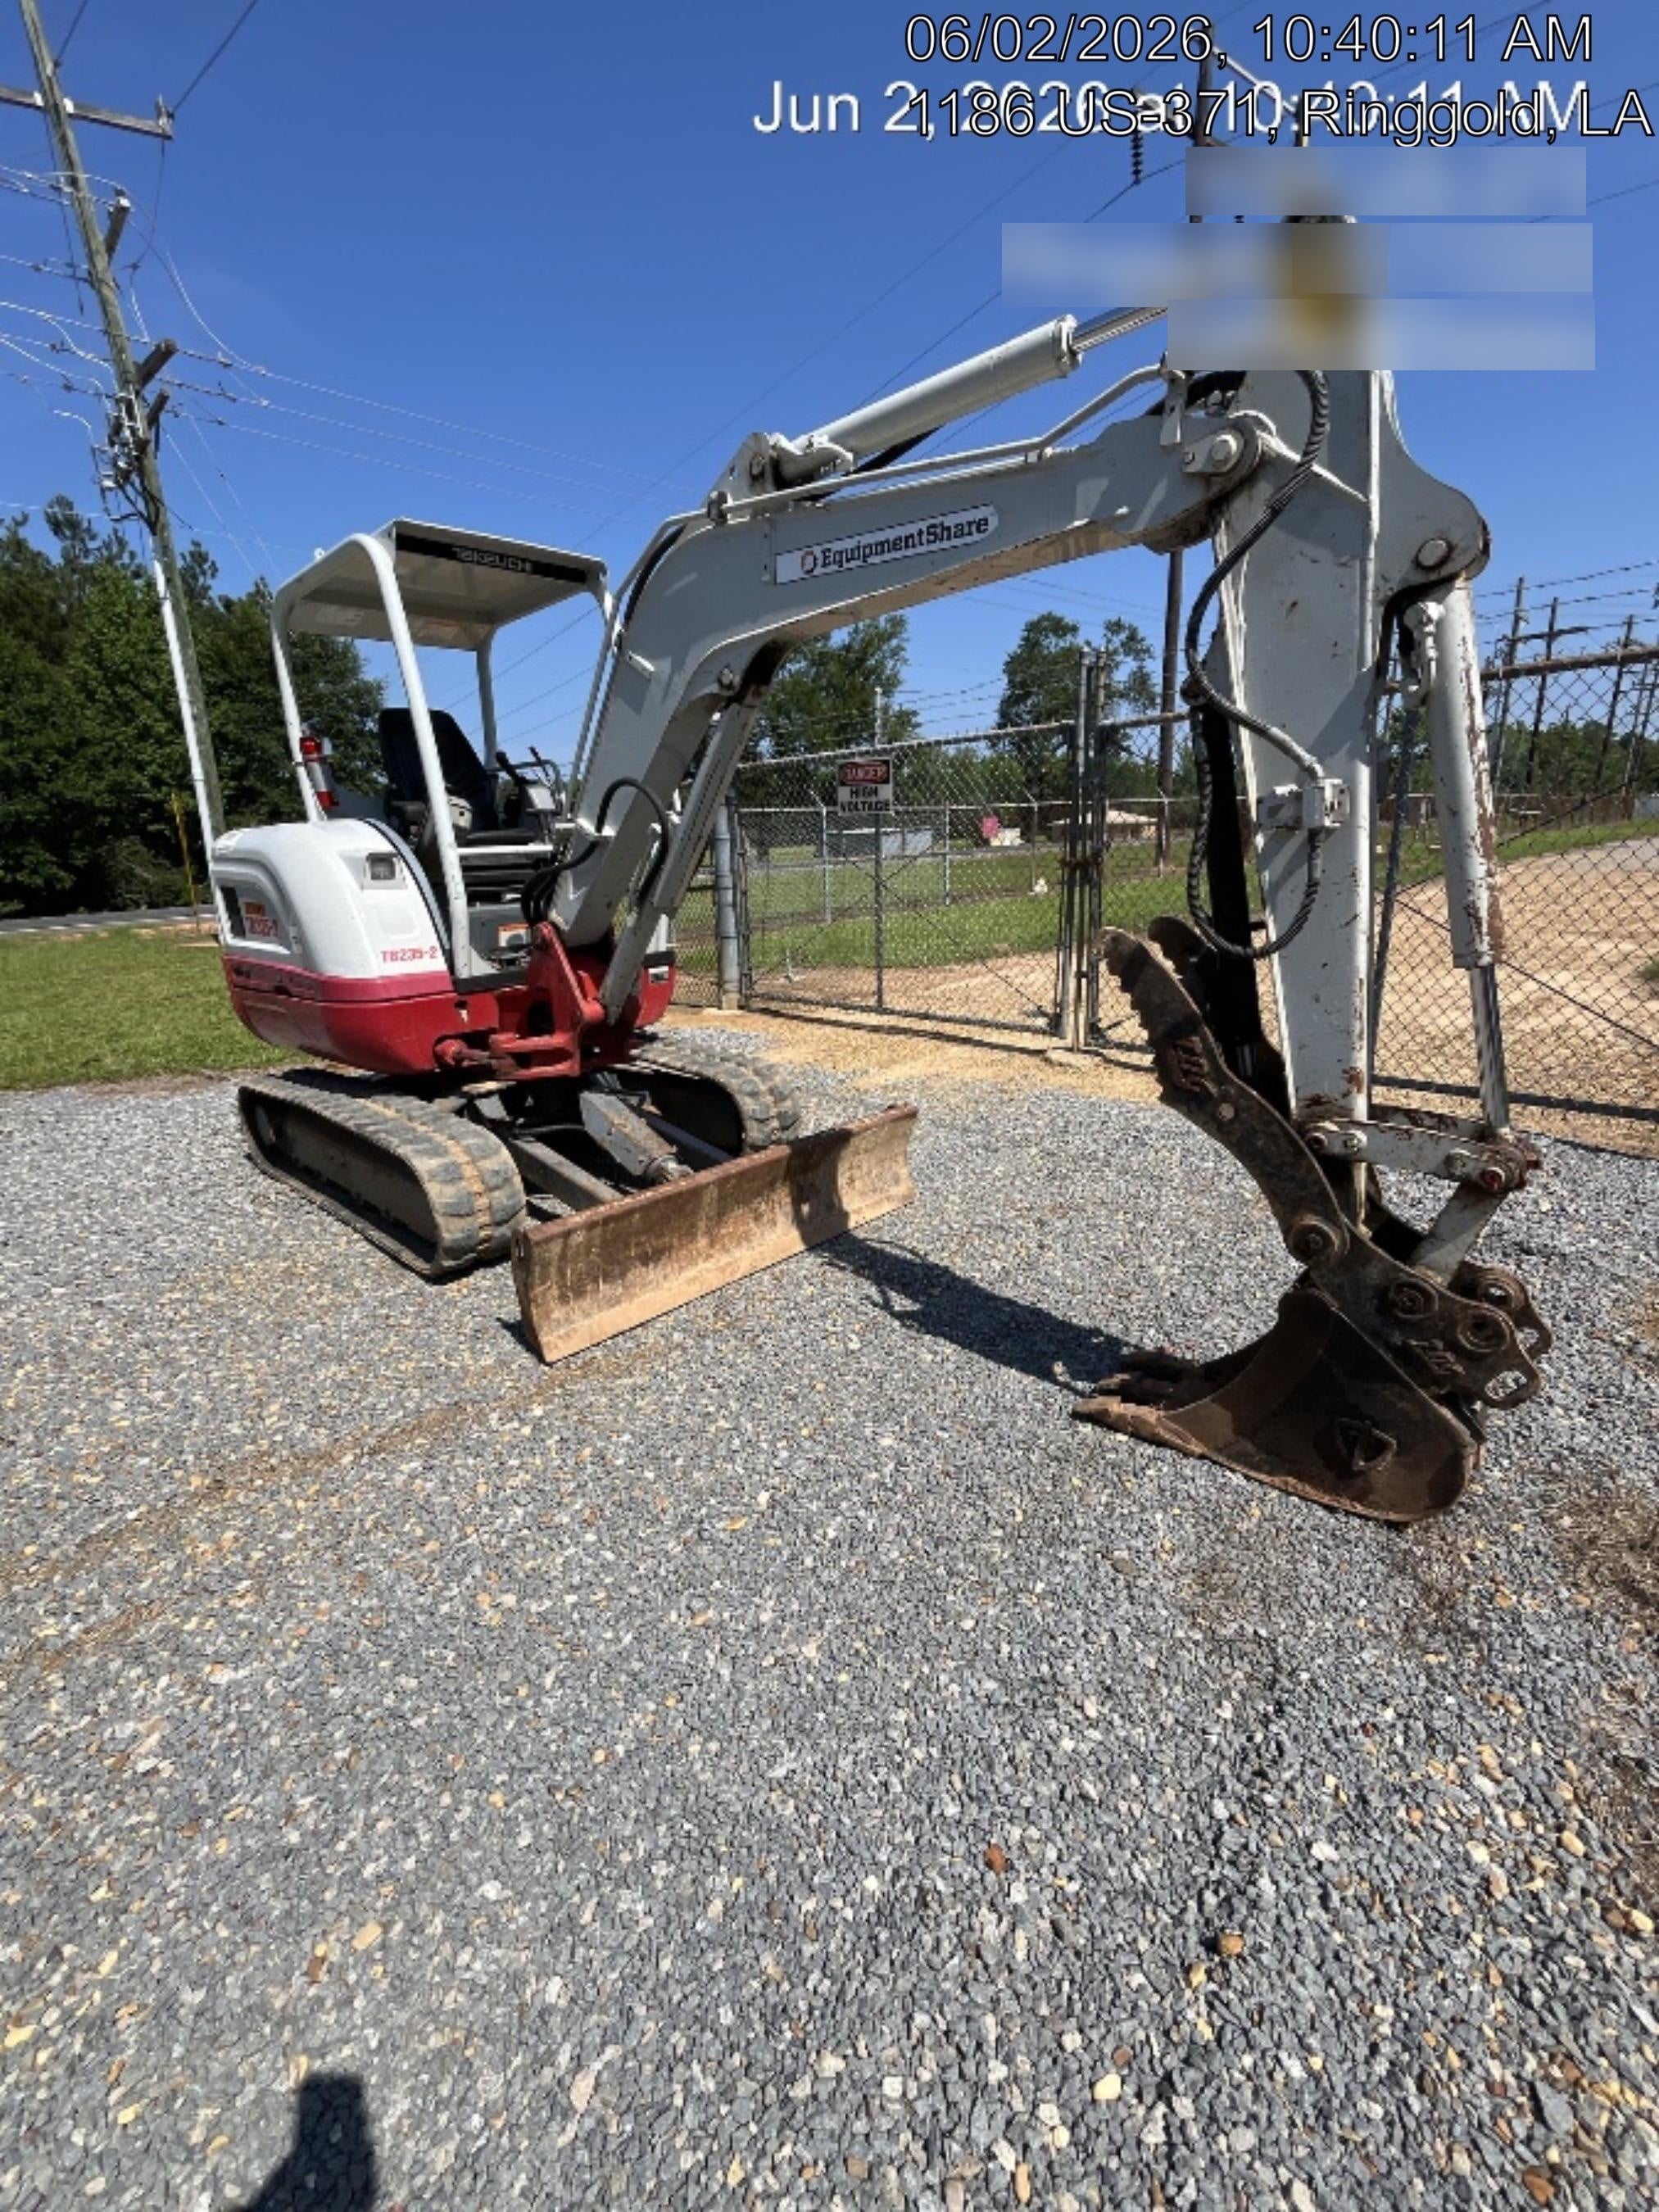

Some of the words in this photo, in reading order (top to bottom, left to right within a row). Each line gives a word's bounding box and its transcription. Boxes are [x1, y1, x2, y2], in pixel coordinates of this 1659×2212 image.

[821, 516, 989, 568] EquipmentShare
[850, 786, 878, 799] HIGH
[840, 800, 891, 812] VOLTAGE
[380, 945, 438, 963] TB235-2
